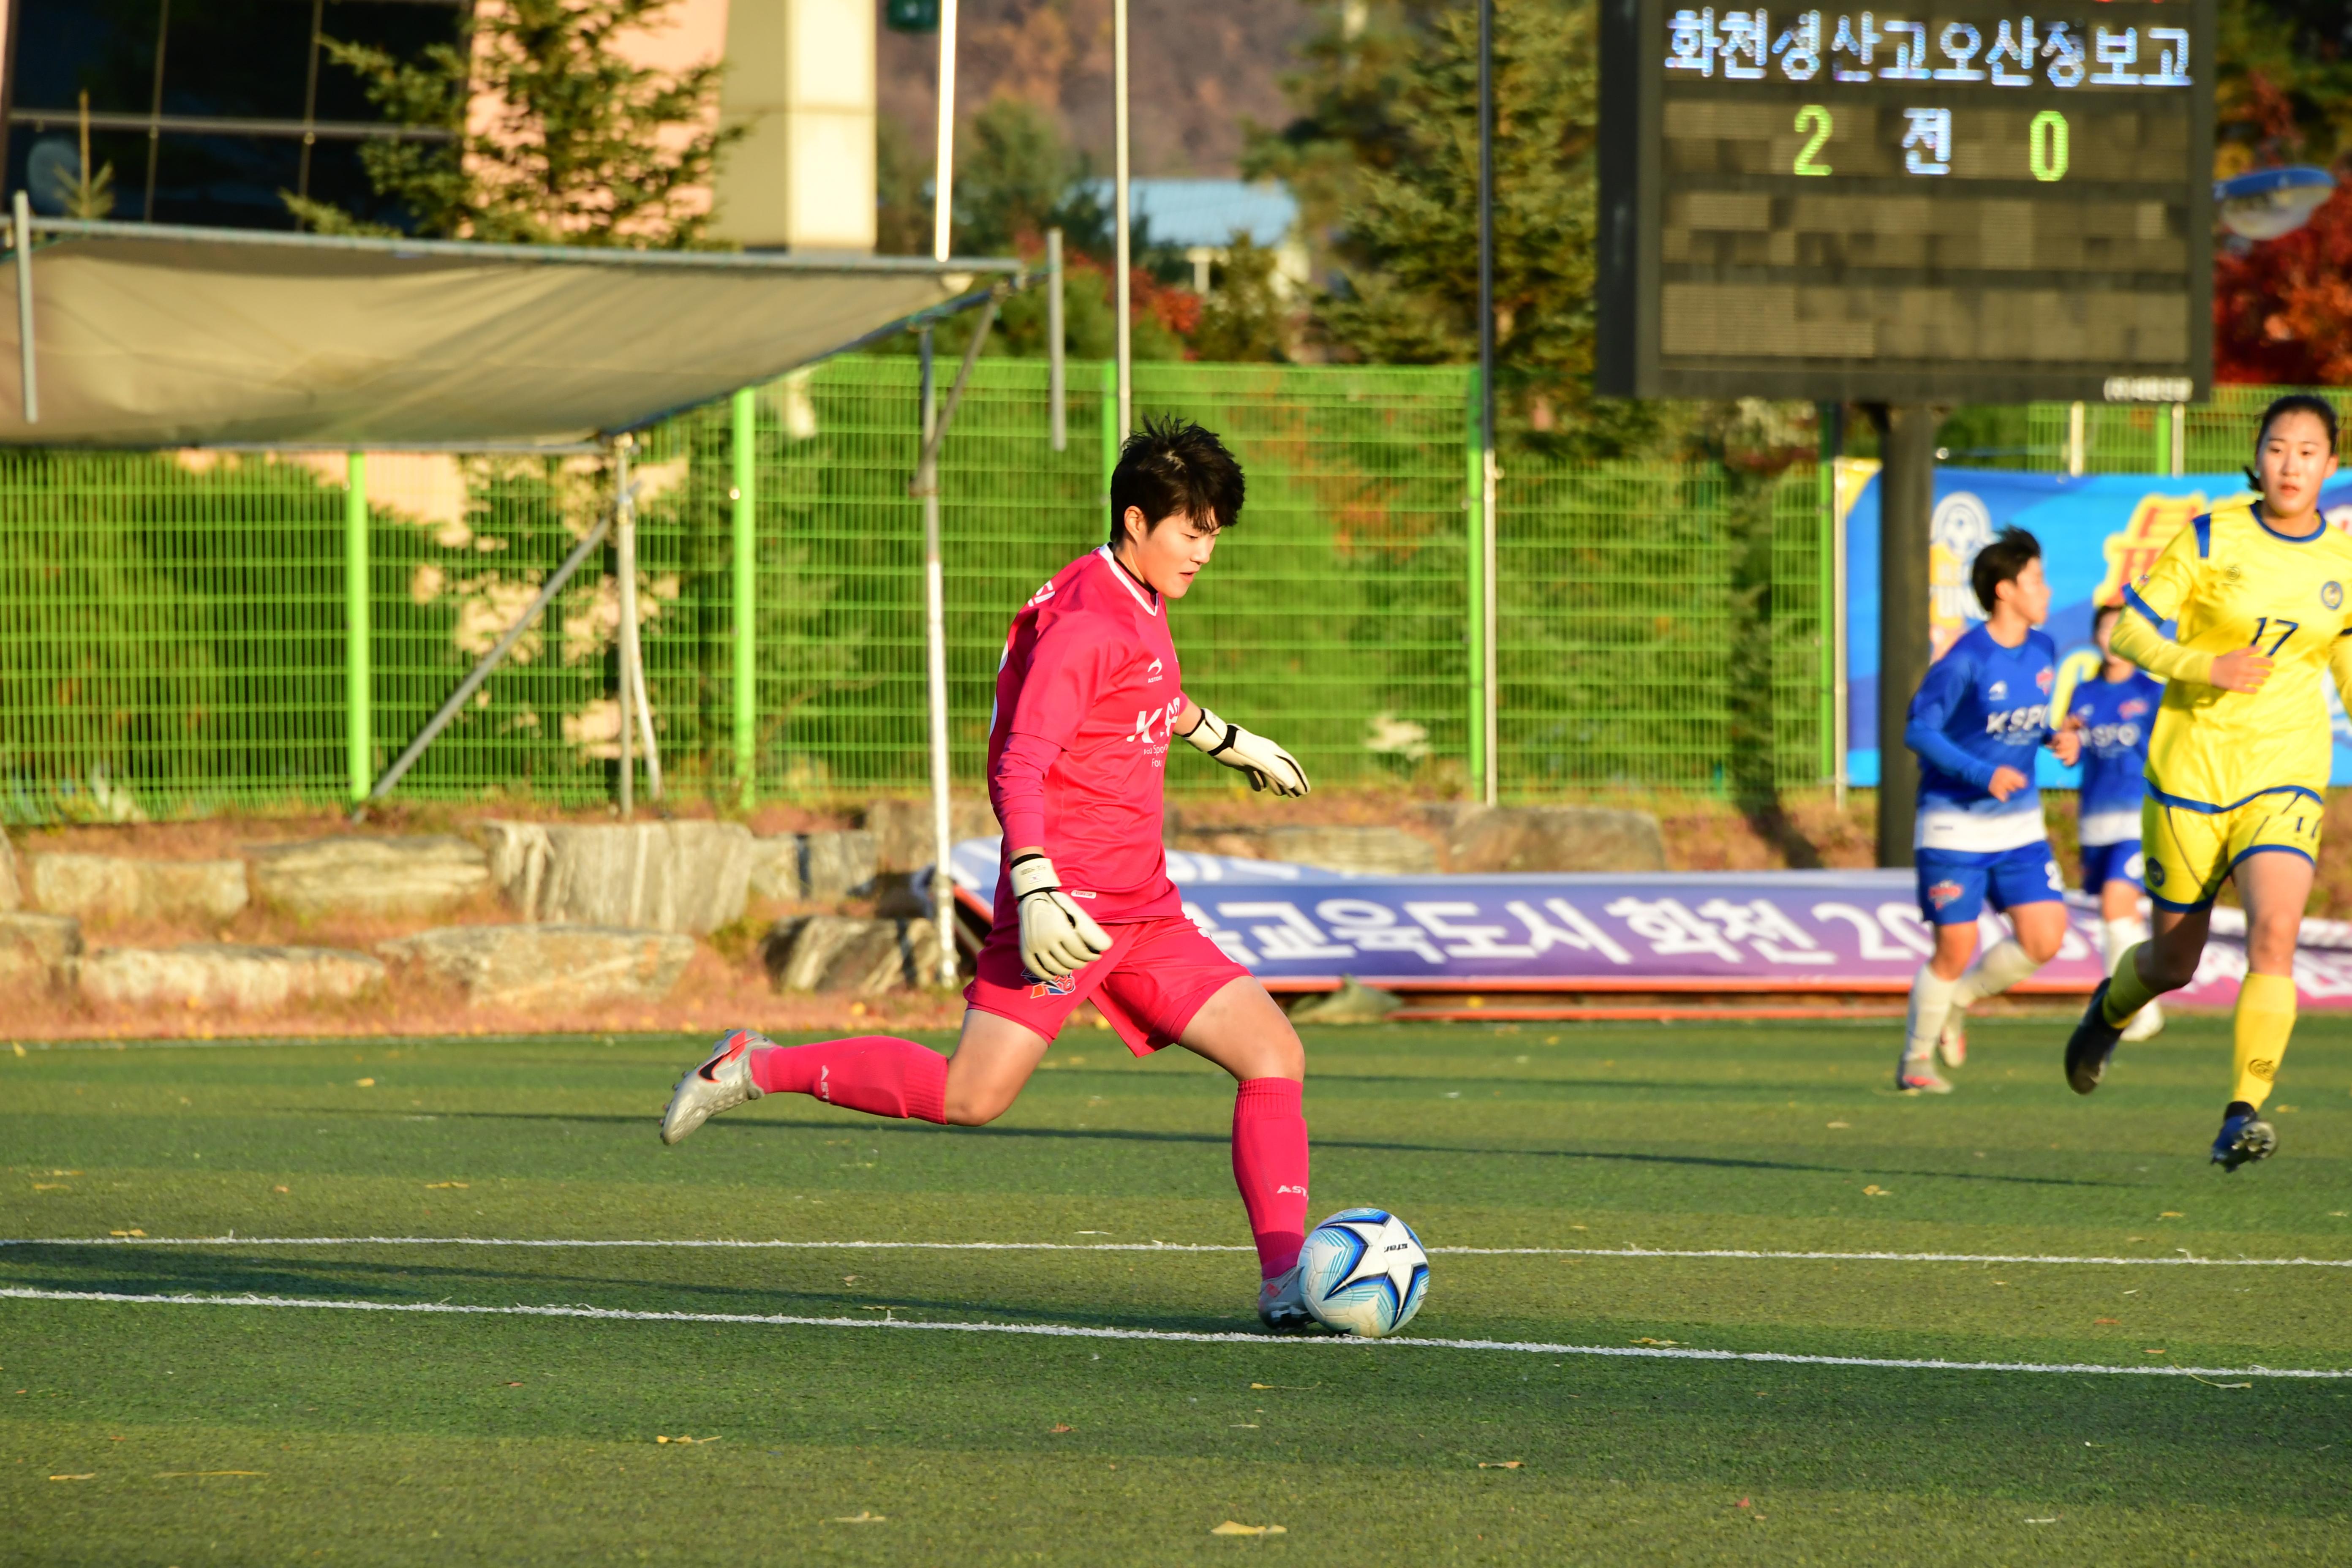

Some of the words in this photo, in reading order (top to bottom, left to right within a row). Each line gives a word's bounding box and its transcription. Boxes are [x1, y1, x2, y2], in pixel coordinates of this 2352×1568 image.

[1794, 105, 1832, 175] 2
[2030, 110, 2069, 181] 0
[2249, 617, 2299, 657] 17
[1603, 896, 1838, 965] 화천
